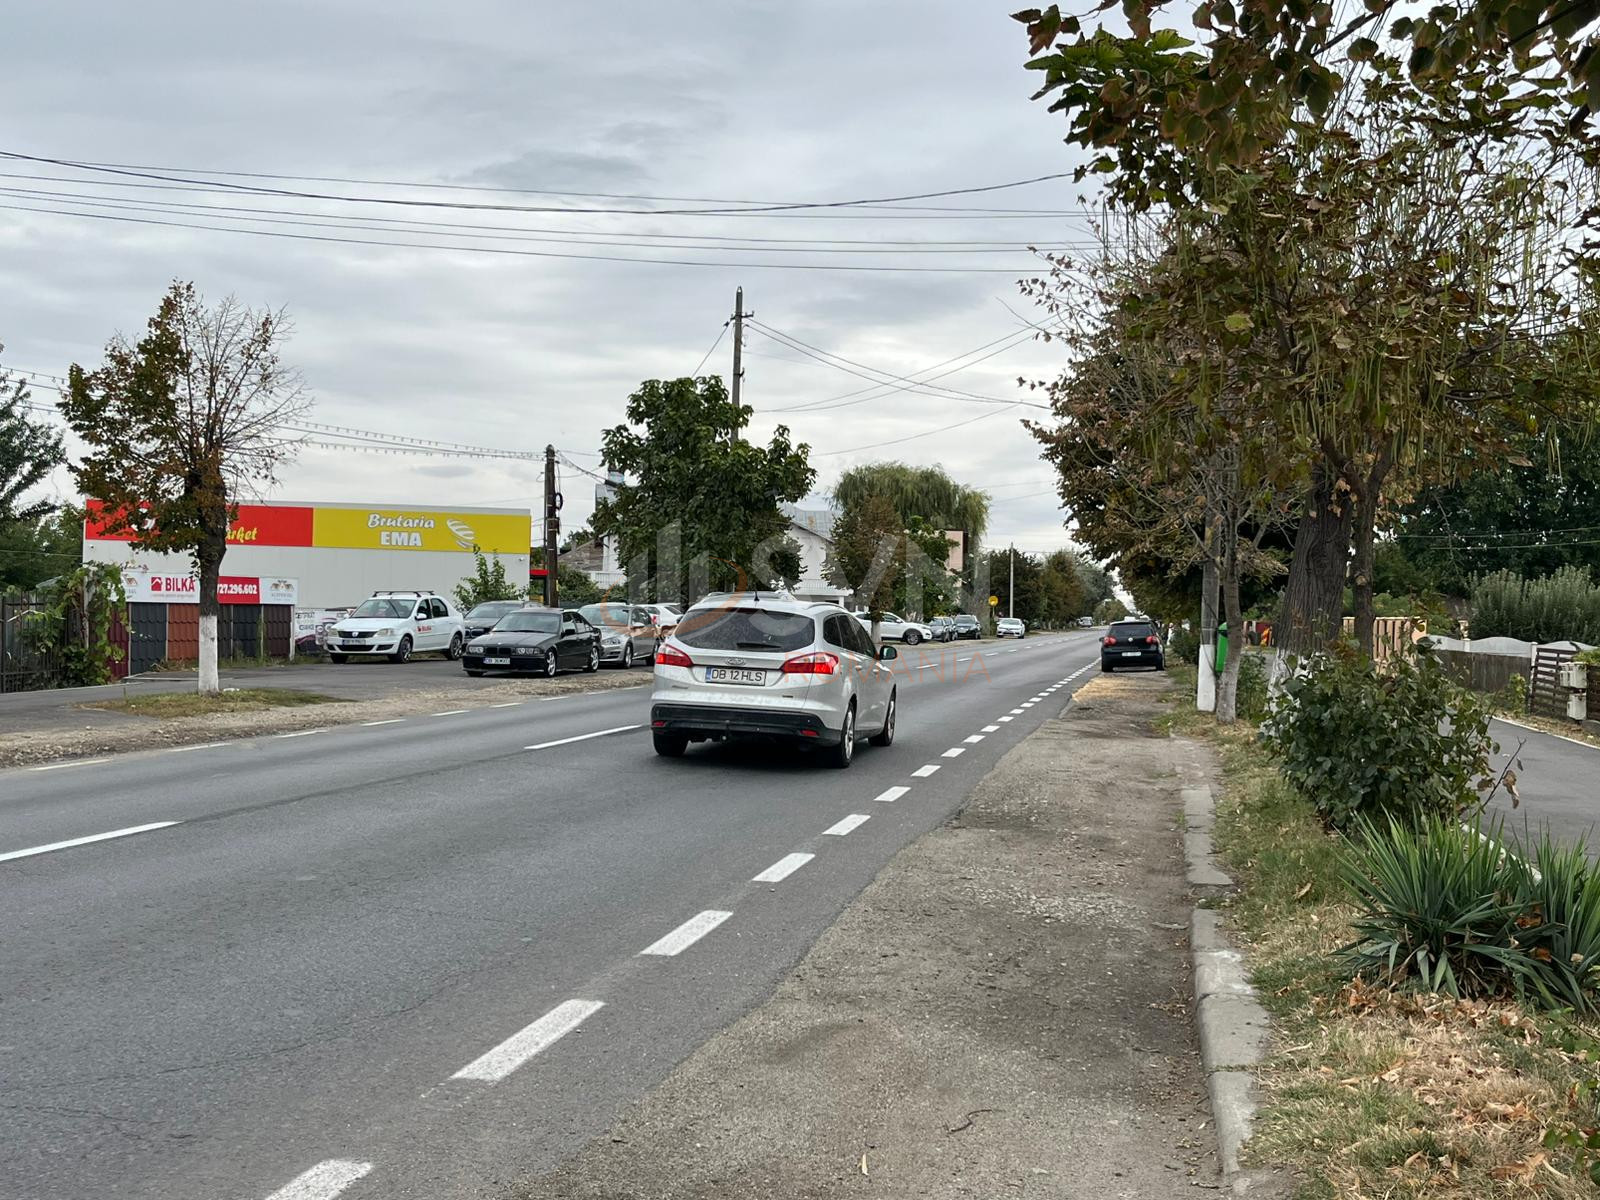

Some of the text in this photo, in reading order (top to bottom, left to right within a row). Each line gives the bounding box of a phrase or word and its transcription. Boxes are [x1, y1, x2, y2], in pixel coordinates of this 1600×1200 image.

[368, 513, 435, 528] Brutaria
[380, 531, 422, 546] EMA
[165, 577, 195, 592] BILKA
[711, 669, 763, 682] DB 12 HLS
